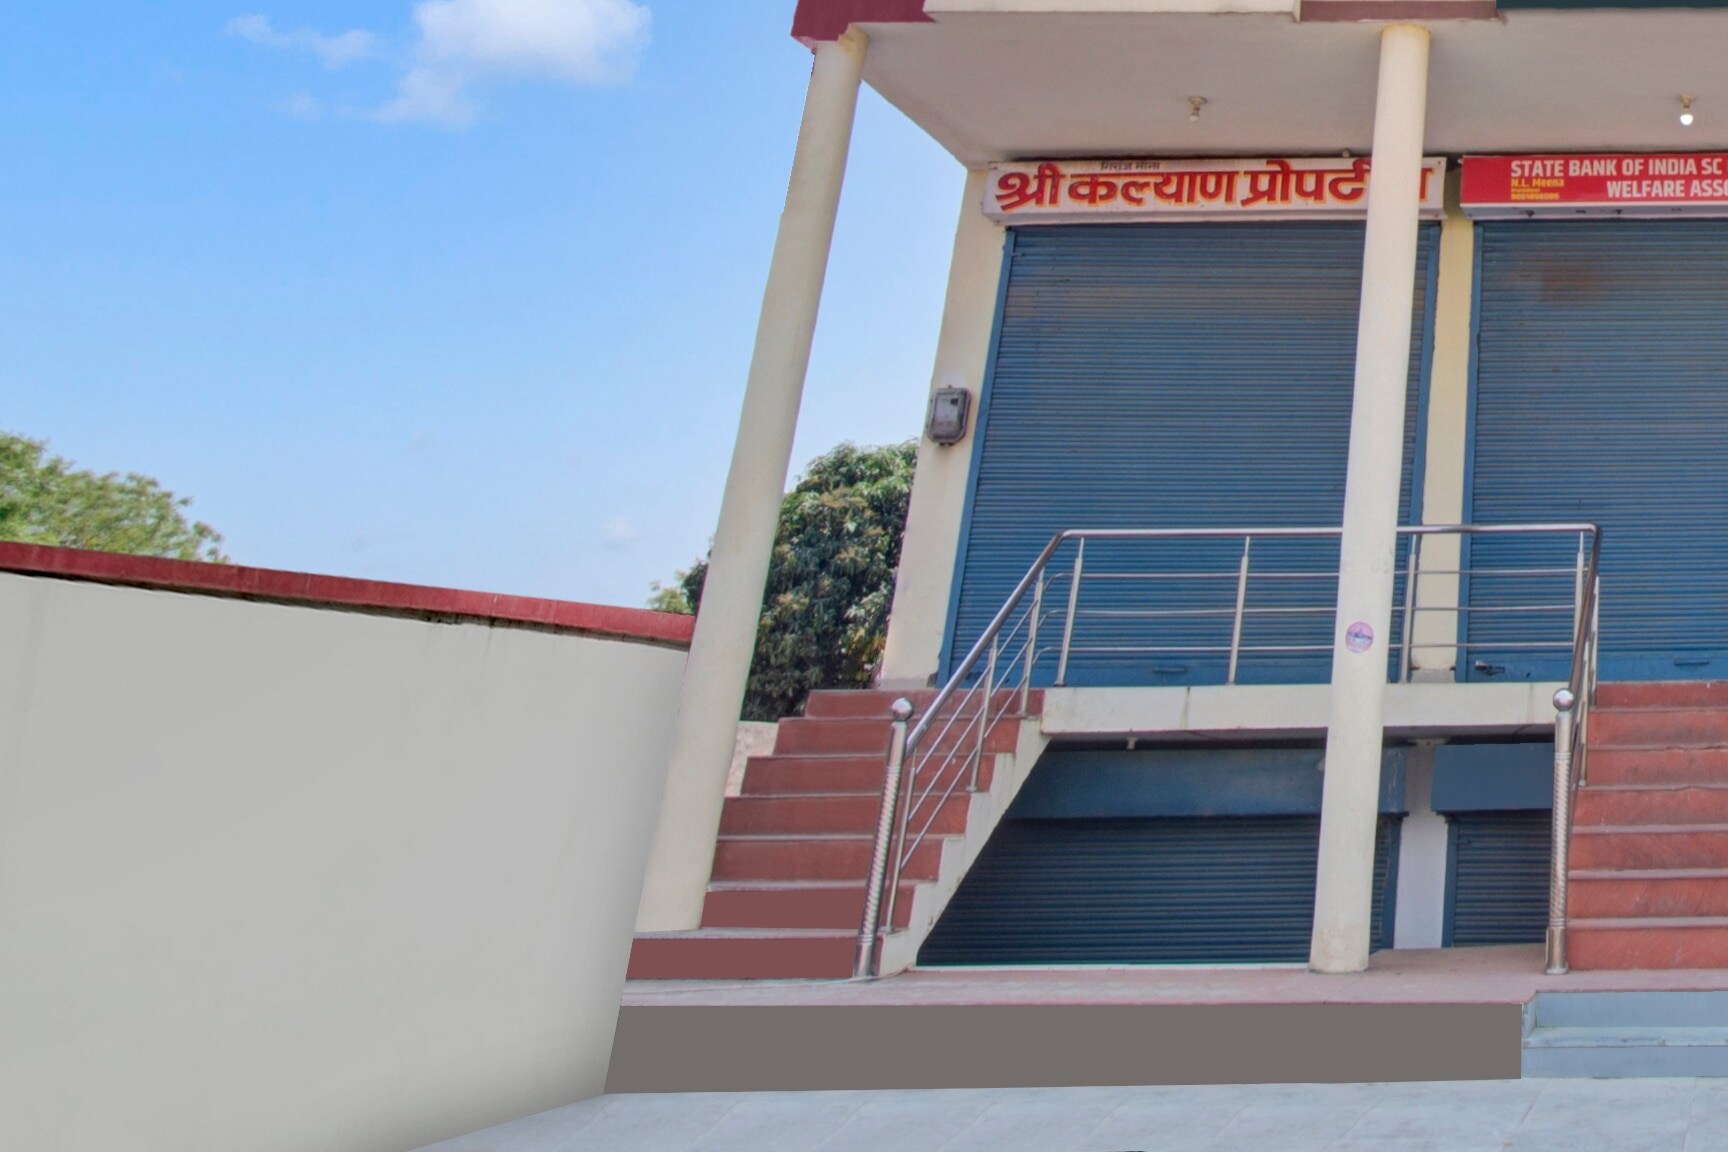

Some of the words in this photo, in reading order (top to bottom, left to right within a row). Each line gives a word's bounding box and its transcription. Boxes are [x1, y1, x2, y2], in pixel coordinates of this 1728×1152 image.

[1511, 159, 1564, 177] STATE
[1569, 159, 1617, 177] BANK
[1622, 158, 1645, 176] OF
[1649, 158, 1697, 175] INDIA
[1701, 157, 1723, 175] SC
[995, 162, 1066, 212] श्री
[1067, 170, 1240, 206] कल्याण
[1532, 178, 1565, 187] Meena
[1607, 180, 1686, 198] WELFARE
